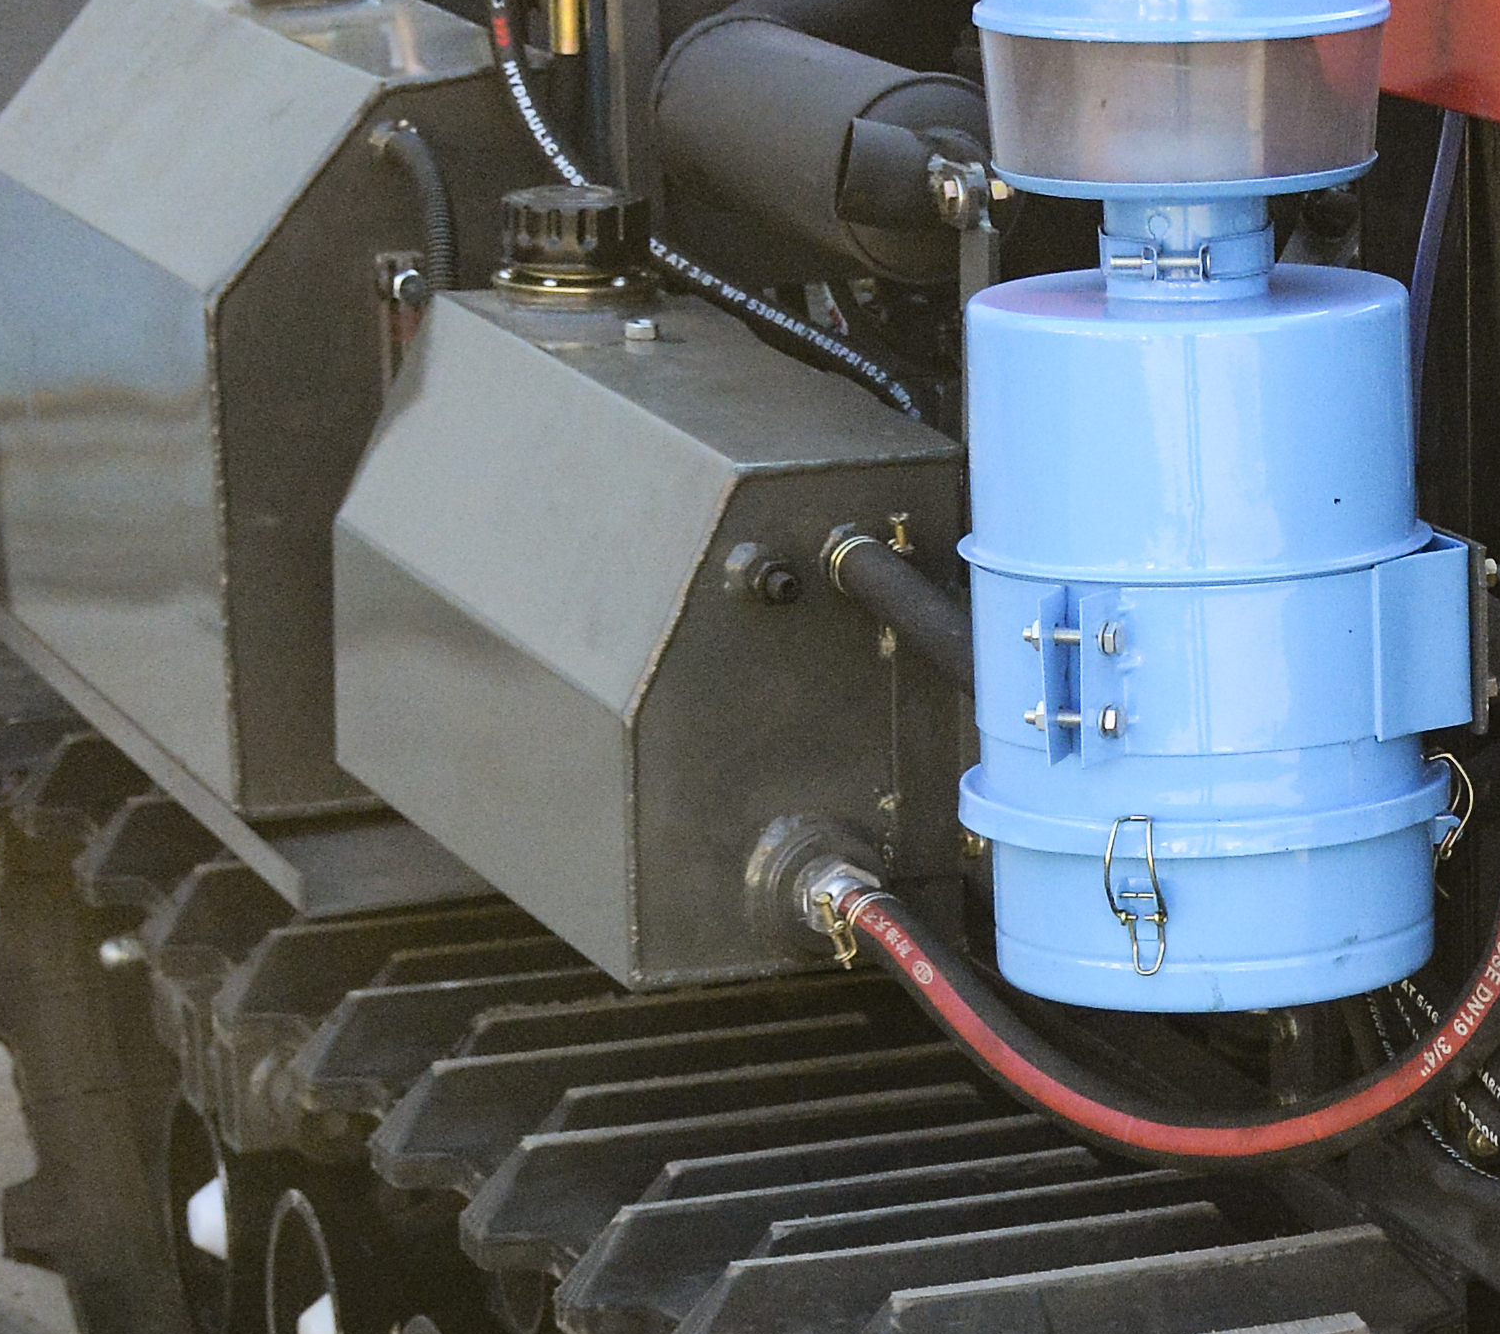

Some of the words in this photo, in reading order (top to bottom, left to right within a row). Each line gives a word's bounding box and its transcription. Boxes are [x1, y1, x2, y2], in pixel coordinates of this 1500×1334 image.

[503, 60, 559, 157] HYDRAULIC
[552, 154, 589, 187] HOS
[665, 252, 690, 270] AT
[720, 283, 747, 303] WP
[1452, 982, 1494, 1037] DN19
